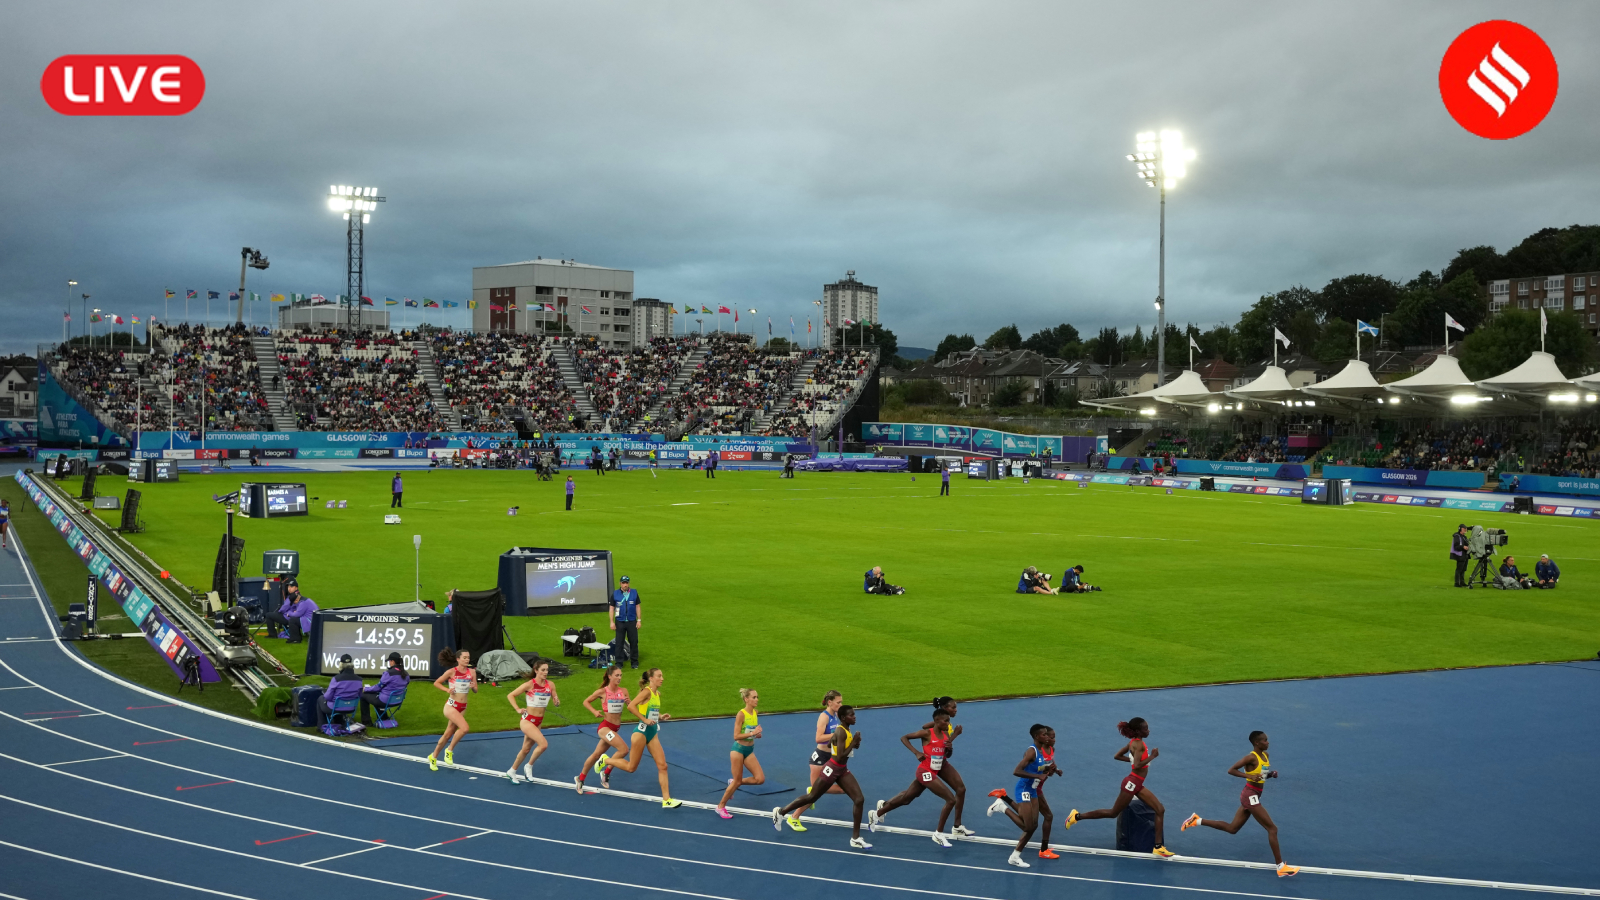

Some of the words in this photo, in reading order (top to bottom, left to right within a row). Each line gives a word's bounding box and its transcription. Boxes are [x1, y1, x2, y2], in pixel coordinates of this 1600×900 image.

[262, 433, 290, 442] games
[603, 442, 621, 450] sport
[631, 442, 644, 451] just
[658, 442, 694, 451] beginning
[276, 556, 292, 570] 14
[538, 562, 558, 570] MEN'S
[355, 626, 424, 646] 14:59.5
[322, 652, 376, 670] Woen's
[380, 654, 429, 671] 100m
